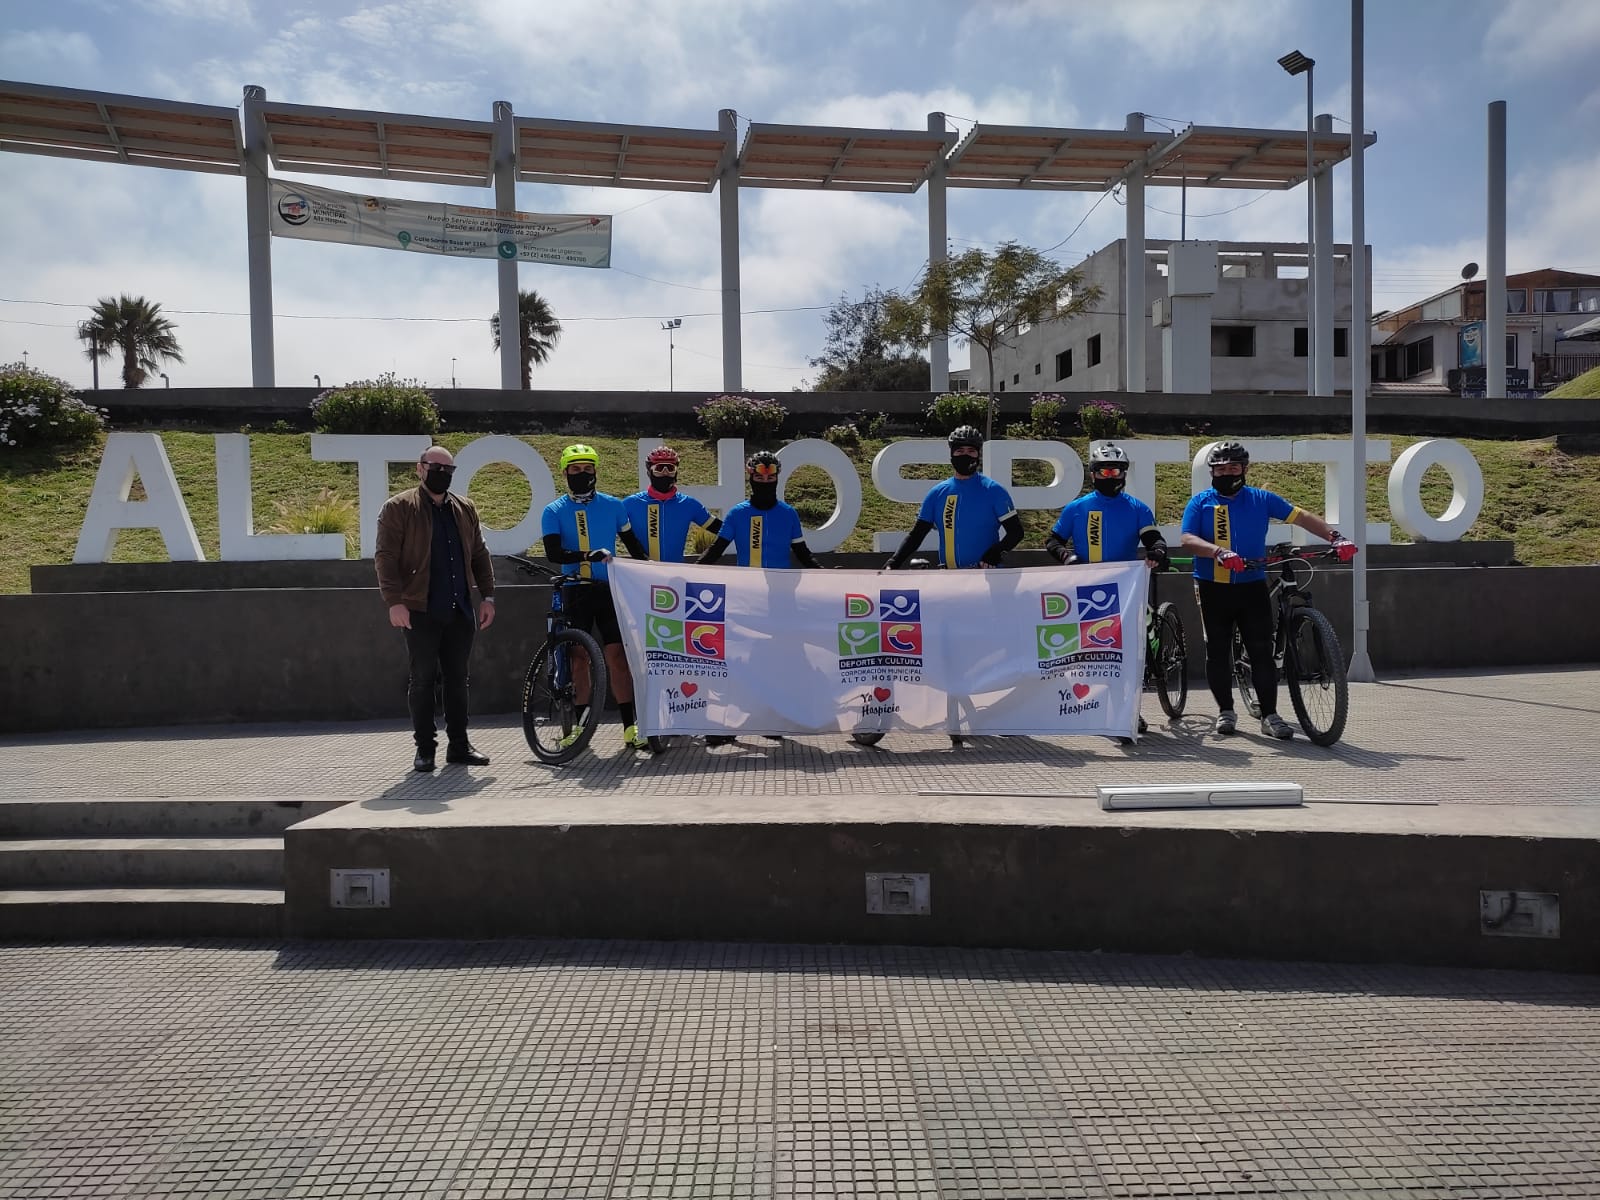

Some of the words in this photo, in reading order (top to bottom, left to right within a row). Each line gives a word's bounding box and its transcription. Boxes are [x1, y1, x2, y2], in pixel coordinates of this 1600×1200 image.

[73, 433, 556, 564] ALTO
[945, 499, 955, 529] MAVIC
[579, 512, 588, 536] MAVIC
[650, 508, 659, 538] MAVIC
[1089, 515, 1100, 546] MAVIC
[1217, 508, 1228, 541] MAVIC
[752, 519, 761, 549] MAVIC
[840, 659, 876, 669] DEPORTE
[885, 657, 921, 666] CULTURA
[1040, 656, 1076, 668] DEPORTE
[1084, 652, 1121, 661] CULTURA
[1087, 663, 1122, 671] MUNICIPAL
[679, 669, 728, 678] HOSPICIO
[841, 675, 867, 684] ALTO
[1070, 670, 1121, 678] HOSPICIO
[666, 688, 679, 699] Yo
[861, 692, 873, 703] Yo
[1058, 688, 1072, 701] Yo
[668, 698, 707, 714] Hospicio
[862, 703, 900, 717] Hospicio
[1059, 699, 1100, 716] Hospicio
